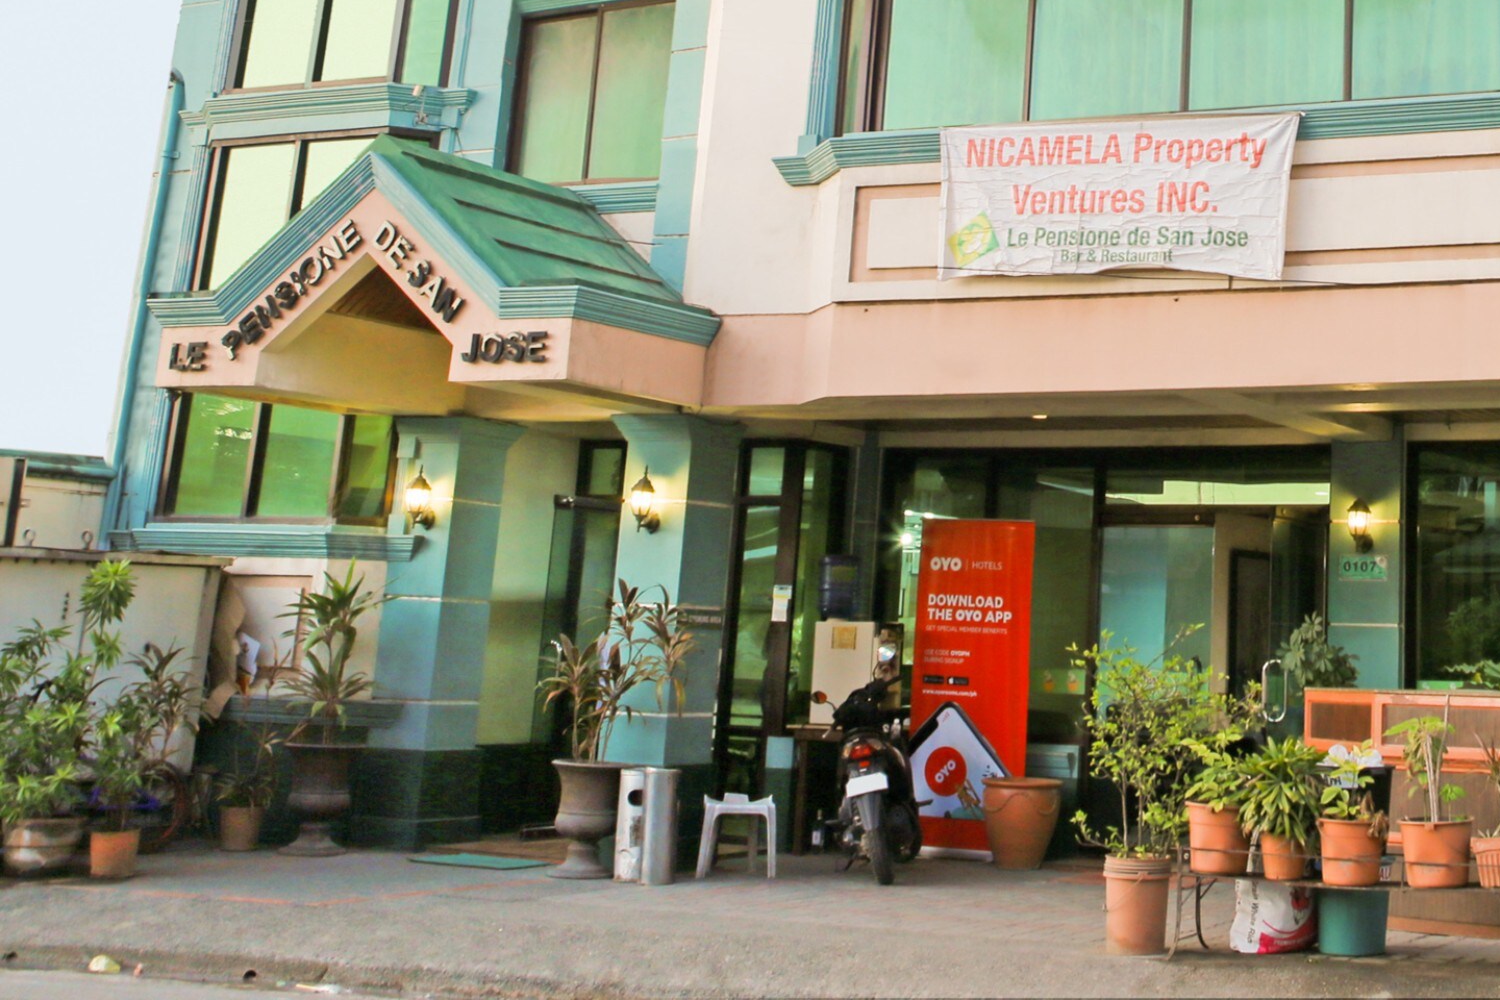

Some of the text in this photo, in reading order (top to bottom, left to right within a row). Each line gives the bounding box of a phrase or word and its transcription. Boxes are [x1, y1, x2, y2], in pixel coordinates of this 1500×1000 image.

[966, 132, 1267, 169] NICAMELA Property
[1013, 181, 1218, 215] Ventures INC.
[1007, 226, 1249, 247] Le Pensione de San Jose
[1061, 249, 1173, 263] Bar & Restaurant
[169, 219, 549, 372] LE PENSIONE DE SAN JOSE
[930, 556, 1003, 571] OYO HOTELS
[1343, 561, 1377, 572] 0107
[928, 594, 1003, 608] DOWNLOAD
[928, 608, 1012, 623] THE OYO APP
[935, 760, 956, 783] OYO
